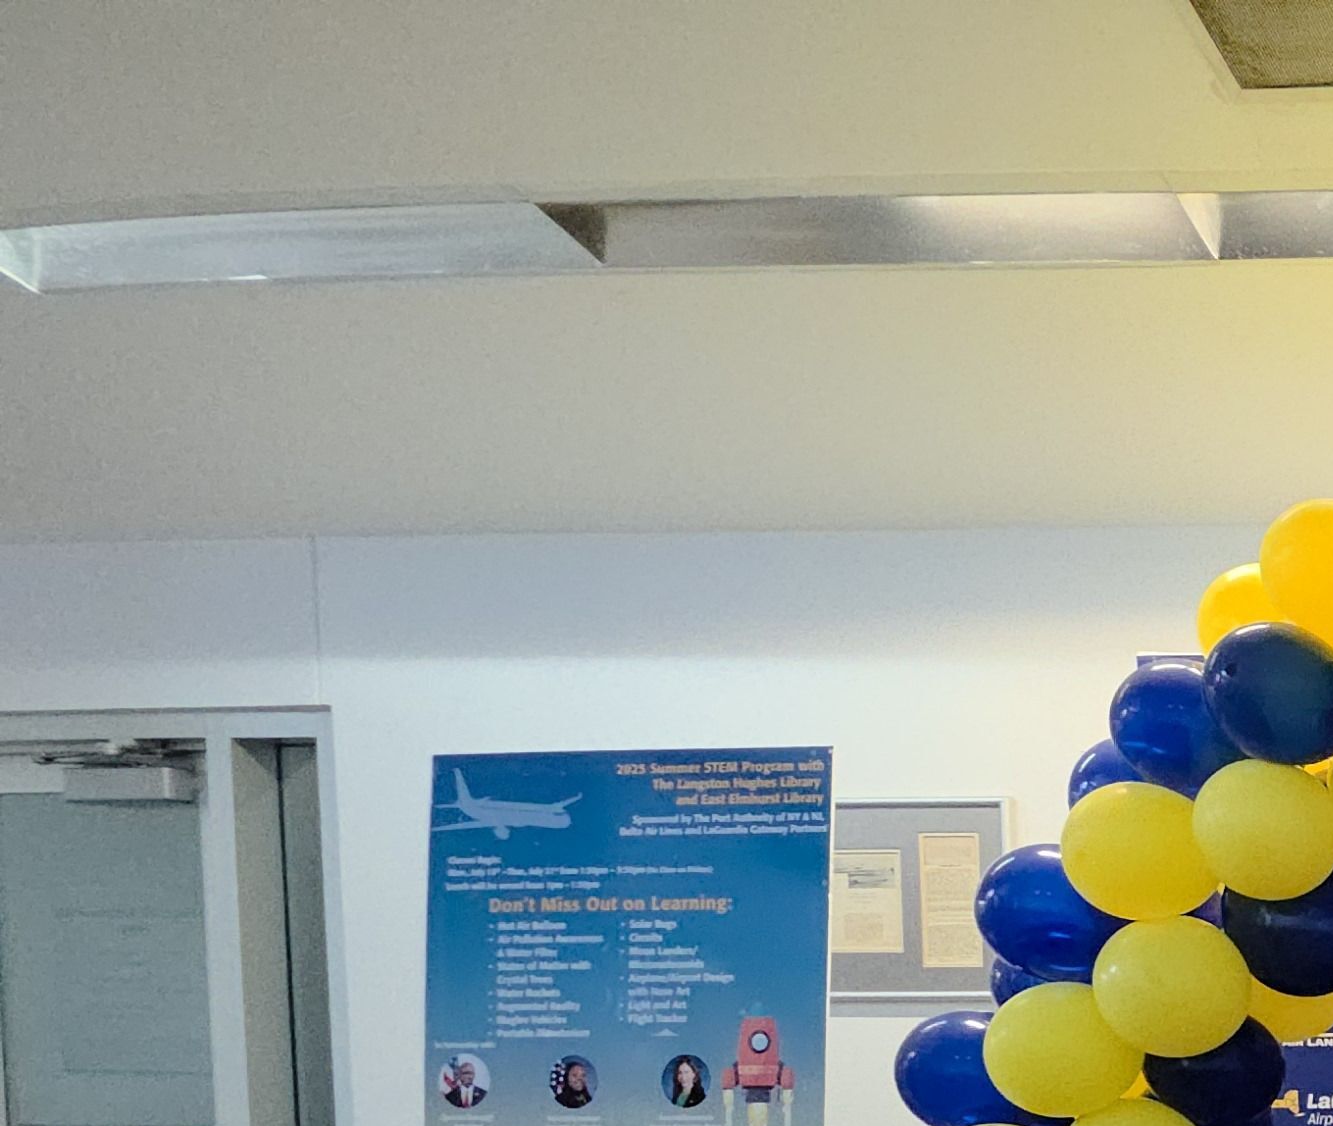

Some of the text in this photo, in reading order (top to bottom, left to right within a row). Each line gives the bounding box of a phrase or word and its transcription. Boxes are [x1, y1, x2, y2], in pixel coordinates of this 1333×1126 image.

[651, 763, 701, 773] Summer
[704, 762, 738, 772] STEM
[742, 761, 793, 774] Program
[799, 760, 824, 771] with
[653, 779, 674, 790] The
[677, 779, 730, 791] Langston
[781, 777, 821, 790] Library
[701, 794, 725, 804] East
[784, 793, 824, 806] Library
[489, 896, 733, 914] Don't Miss Out on Learning:
